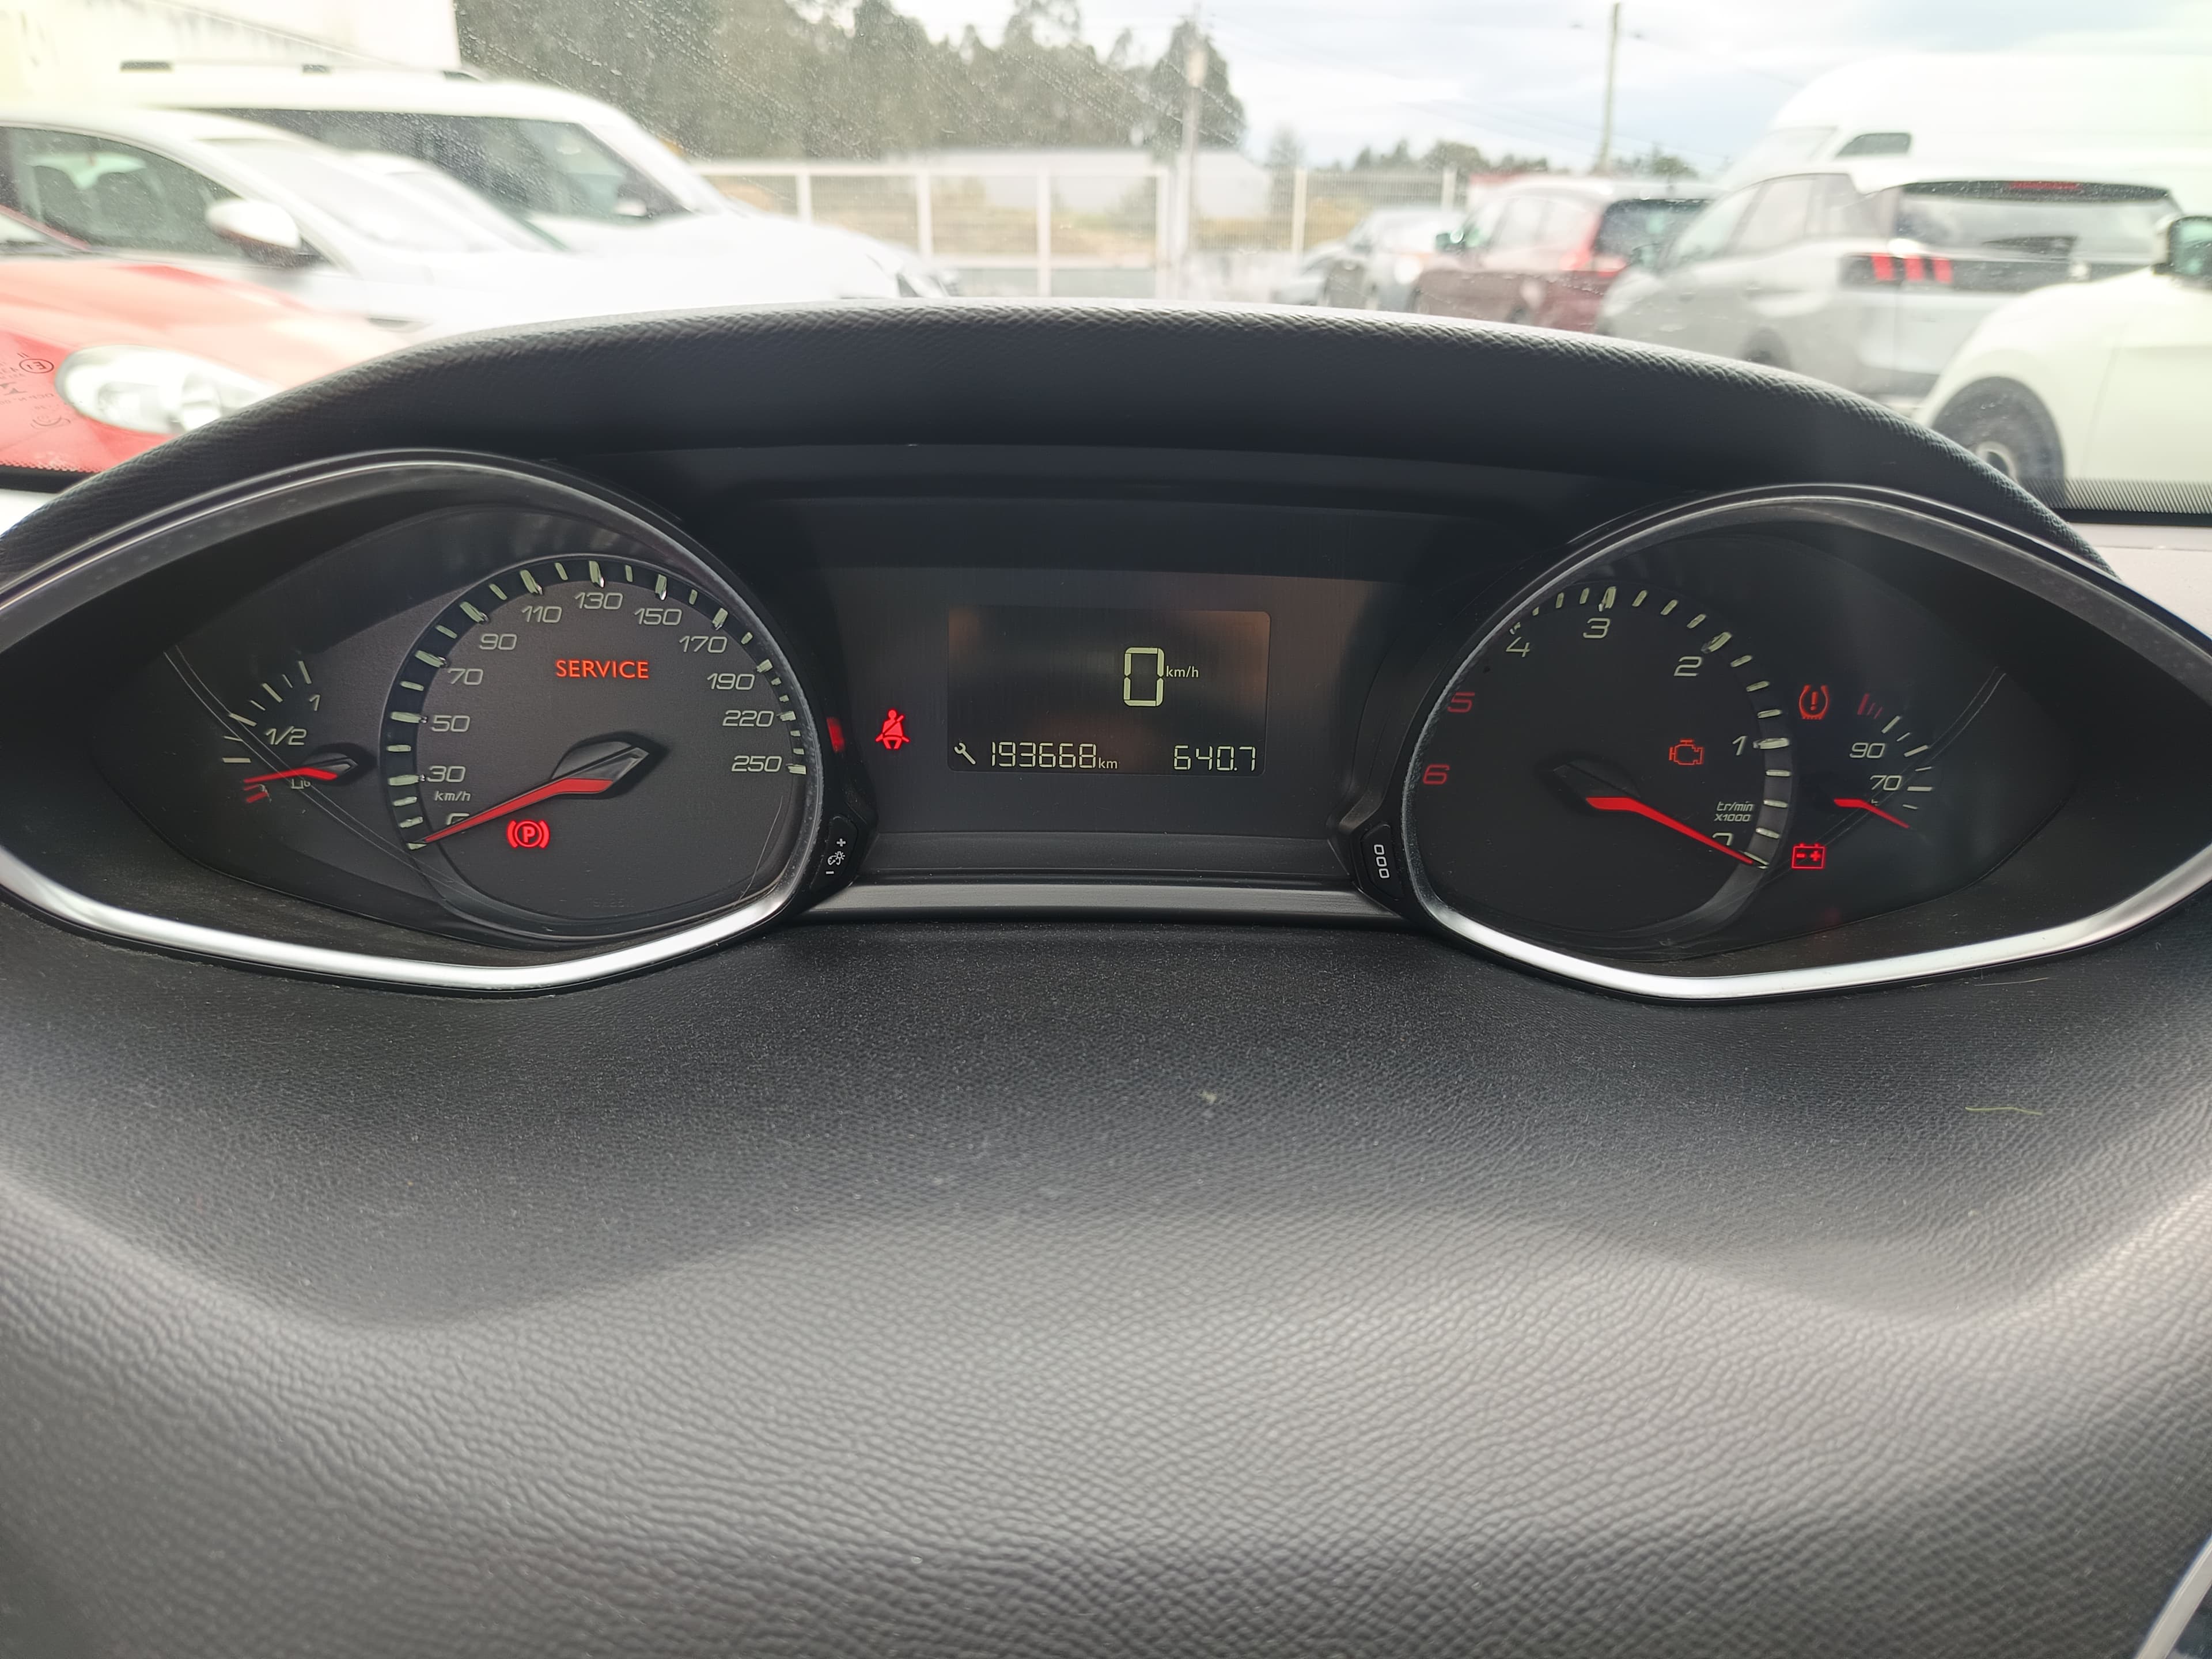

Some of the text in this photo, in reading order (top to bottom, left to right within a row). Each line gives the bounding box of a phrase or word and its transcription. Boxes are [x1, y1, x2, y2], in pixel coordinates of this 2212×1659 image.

[574, 592, 623, 609] 130
[521, 605, 562, 623] 110
[634, 608, 682, 626] 150
[1583, 618, 1611, 639] 3
[479, 633, 517, 650] 90
[679, 635, 728, 653] 170
[1505, 637, 1530, 657] 4
[556, 660, 649, 679] SERVICE
[1673, 656, 1702, 677] 2
[447, 668, 484, 685] 70
[707, 673, 755, 690] 190
[1124, 647, 1199, 707] 0 km/h
[309, 694, 320, 711] 1
[1447, 692, 1475, 713] 5
[431, 715, 471, 732] 50
[722, 710, 774, 727] 220
[264, 726, 308, 745] 1/2
[992, 741, 1118, 769] 193668 km
[1732, 736, 1747, 756] 1
[1849, 742, 1885, 759] 90
[731, 755, 782, 772] 250
[427, 766, 466, 782] 30
[1422, 764, 1450, 785] 6
[1870, 775, 1902, 791] 70
[434, 790, 471, 801] km/h
[1717, 801, 1754, 812] tr/min
[522, 825, 536, 843] P
